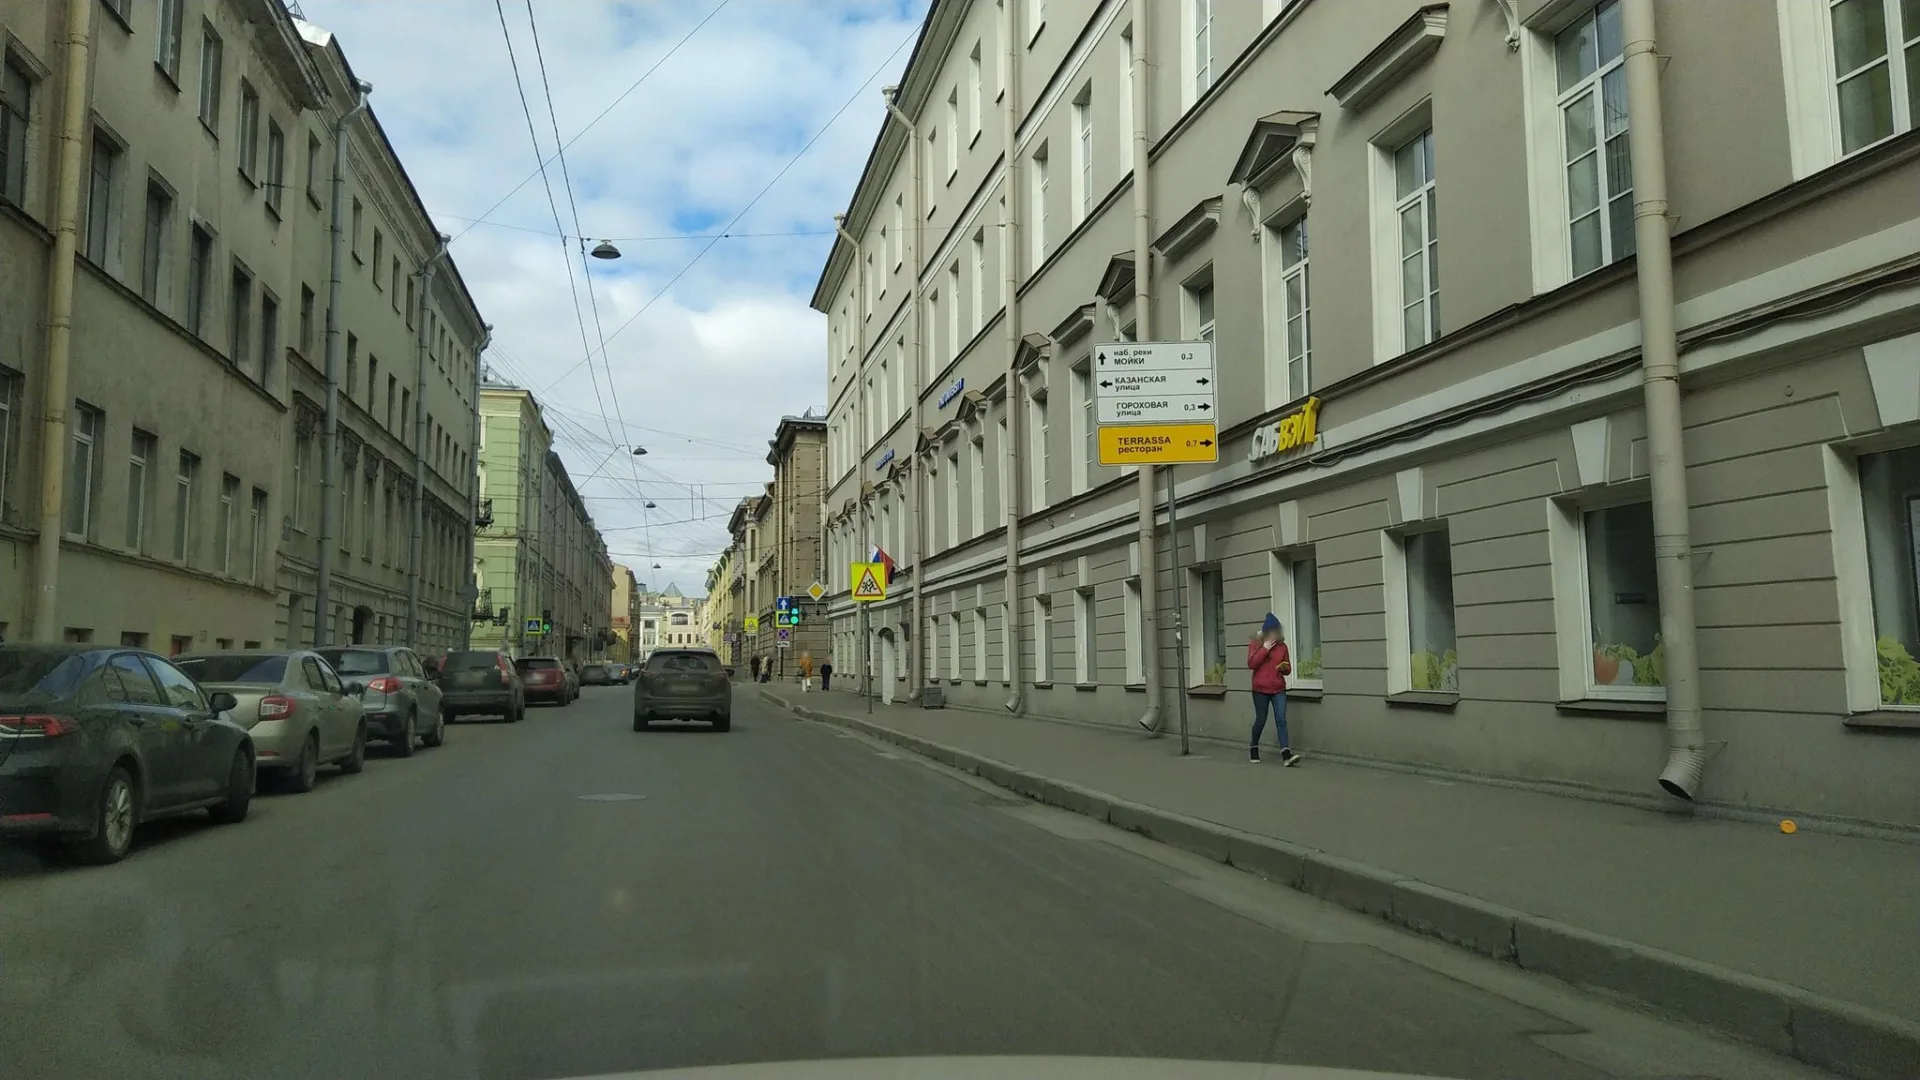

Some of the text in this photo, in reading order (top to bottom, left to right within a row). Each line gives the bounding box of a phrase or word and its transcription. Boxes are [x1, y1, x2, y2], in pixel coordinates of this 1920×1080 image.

[1114, 357, 1145, 365] МОЙКИ
[1115, 376, 1167, 384] КАЗАНСКАЯ
[1115, 384, 1140, 392] улица
[1116, 401, 1168, 409] ГОРОХОВАЯ
[1116, 410, 1141, 418] улица
[1118, 436, 1171, 445] TERRASSA
[1118, 445, 1163, 455] ресторан
